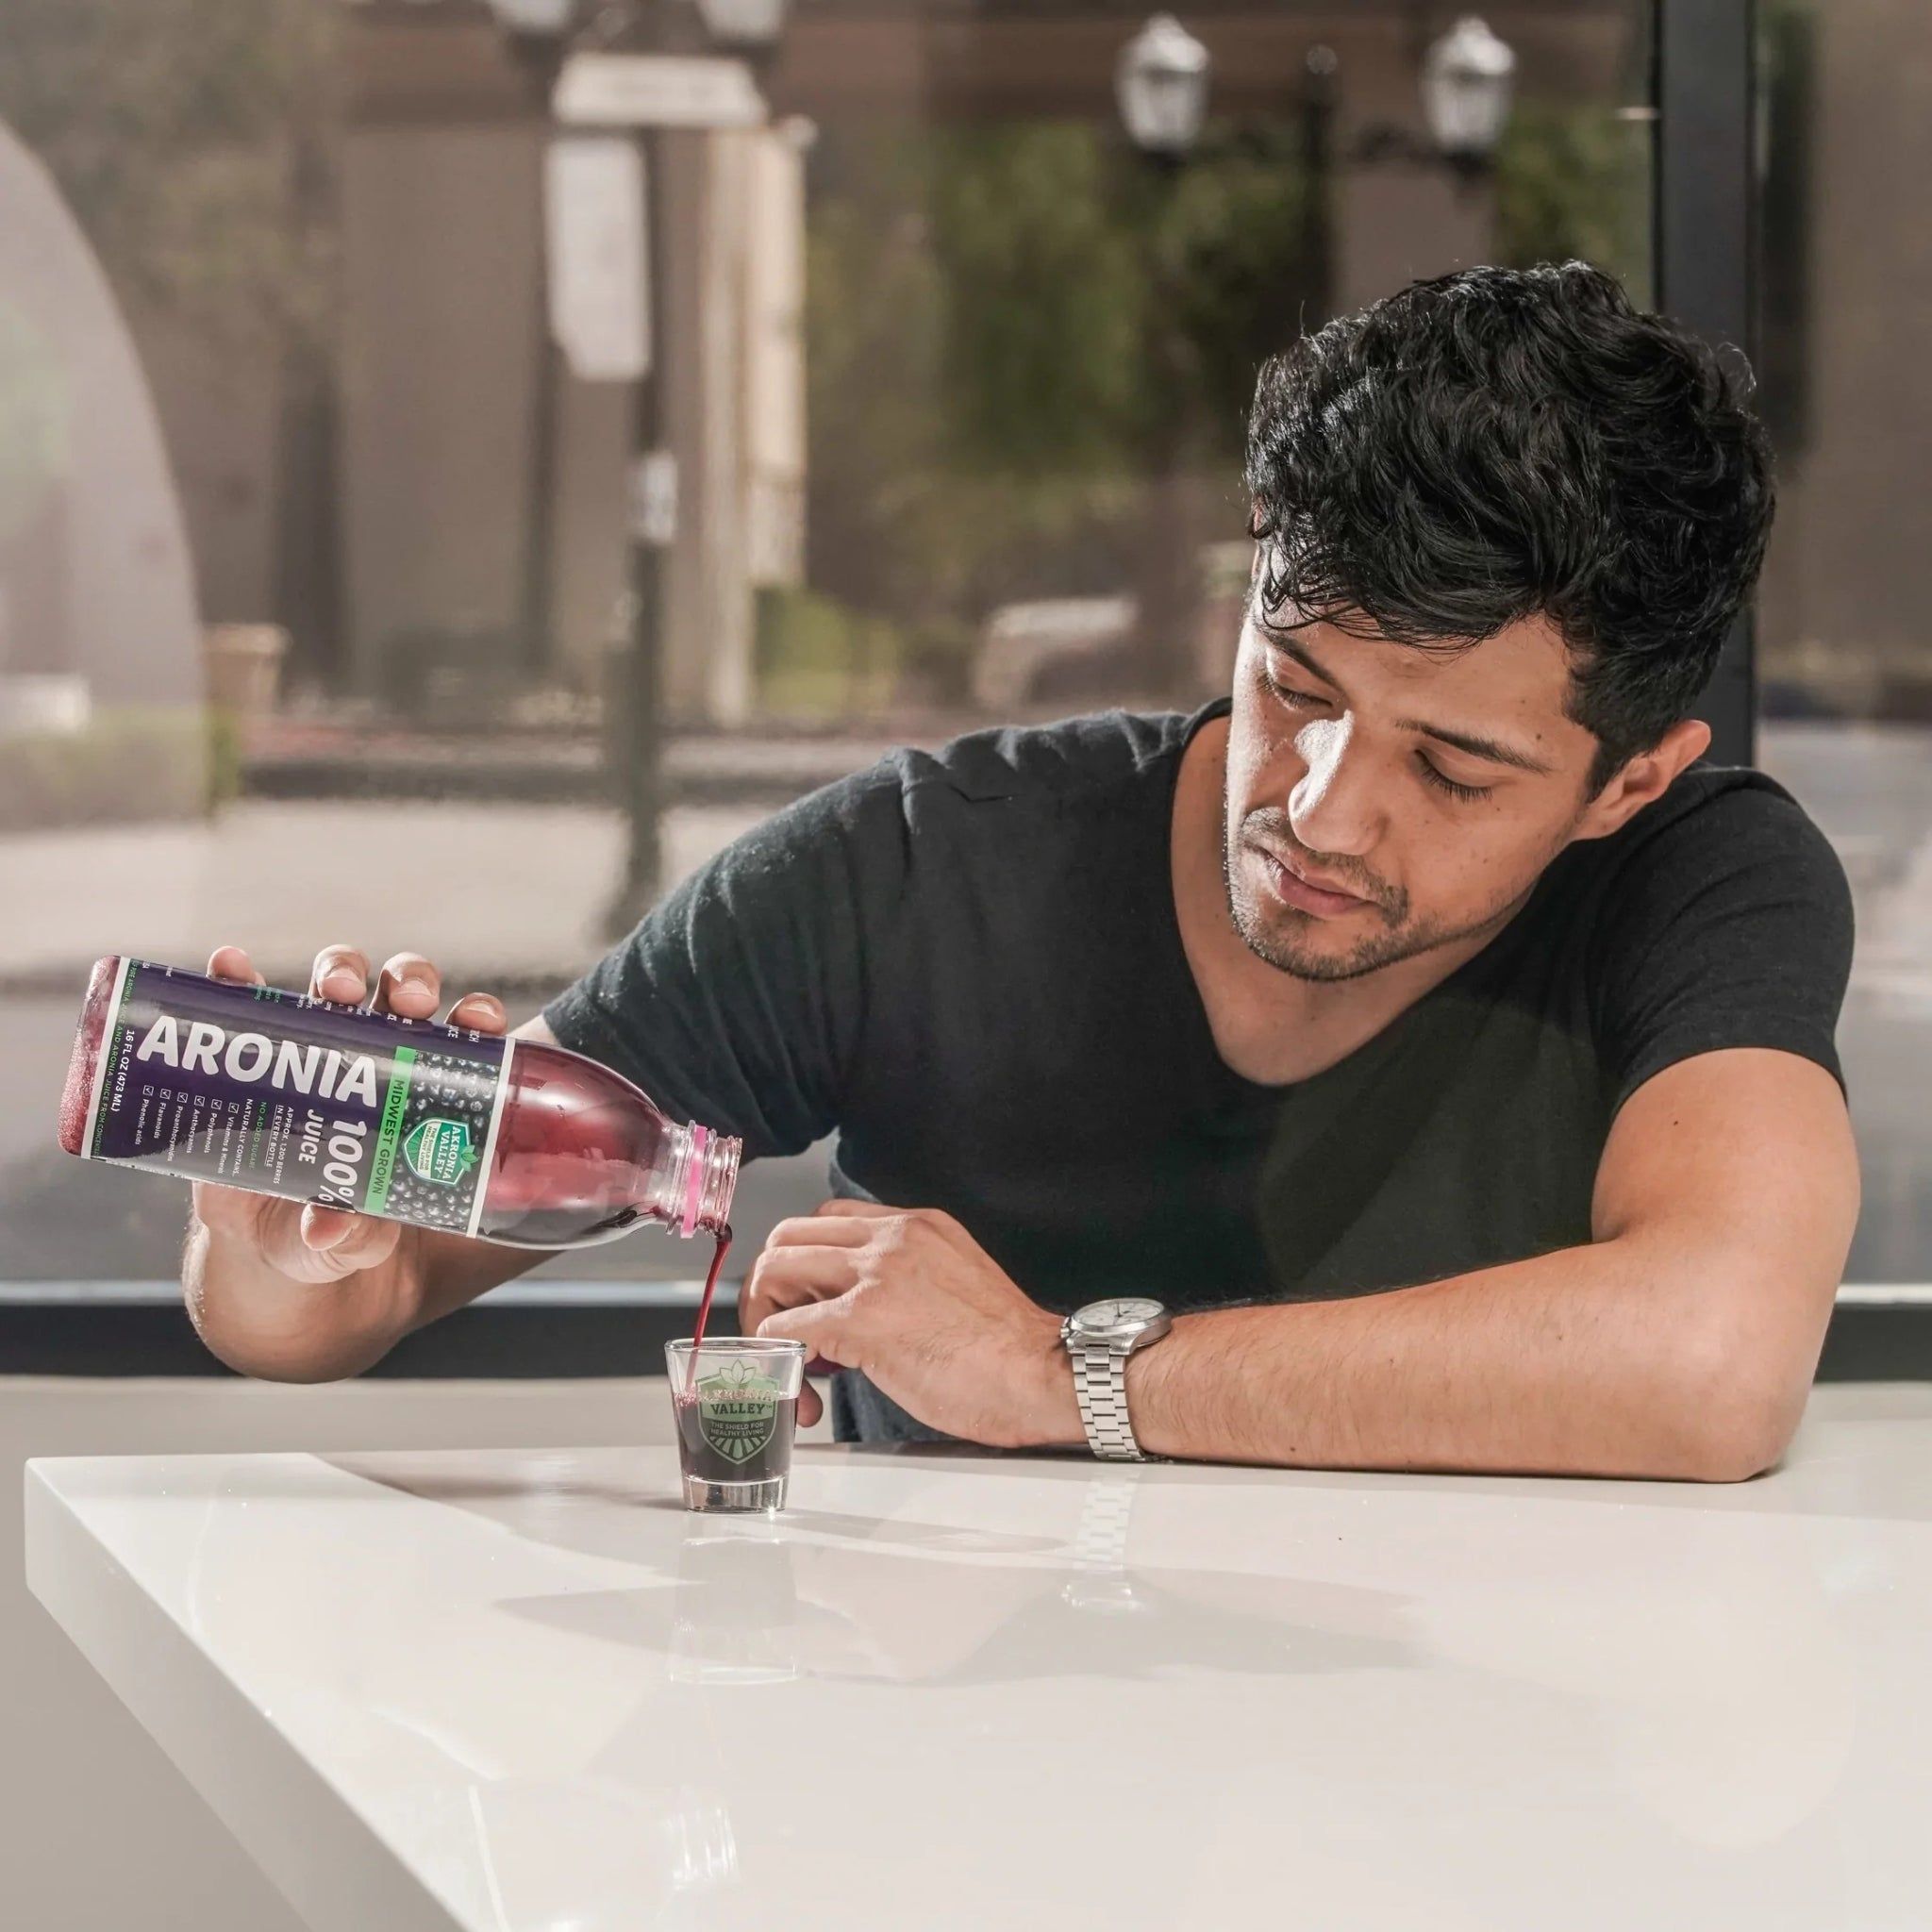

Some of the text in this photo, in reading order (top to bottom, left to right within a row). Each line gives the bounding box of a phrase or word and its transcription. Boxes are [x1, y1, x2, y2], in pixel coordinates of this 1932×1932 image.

[123, 978, 133, 1001] ARONIA
[107, 1044, 118, 1075] ARONIA
[110, 1029, 134, 1111] 16 FL OZ (473 ML)
[136, 1015, 376, 1108] ARONIA
[102, 1078, 111, 1101] JUICE
[258, 1101, 266, 1113] NO
[98, 1103, 107, 1123] FROM
[137, 1098, 148, 1128] Phenolic
[186, 1108, 199, 1153] Anthocyanins
[204, 1112, 217, 1153] Polyphenols
[223, 1116, 233, 1145] Vitamins
[239, 1098, 252, 1143] NATURALLY
[253, 1115, 263, 1141] ADDED
[266, 1105, 283, 1167] IN EVERY BOTTLE
[273, 1107, 293, 1184] APPROX. 1,200 BERRIES
[298, 1108, 323, 1164] JUICE
[373, 1079, 403, 1193] MIDWEST GROWN
[434, 1130, 449, 1174] VALLEY
[442, 1125, 461, 1178] AKRONIA
[317, 1120, 367, 1204] 100%
[710, 1403, 765, 1414] VALLEY
